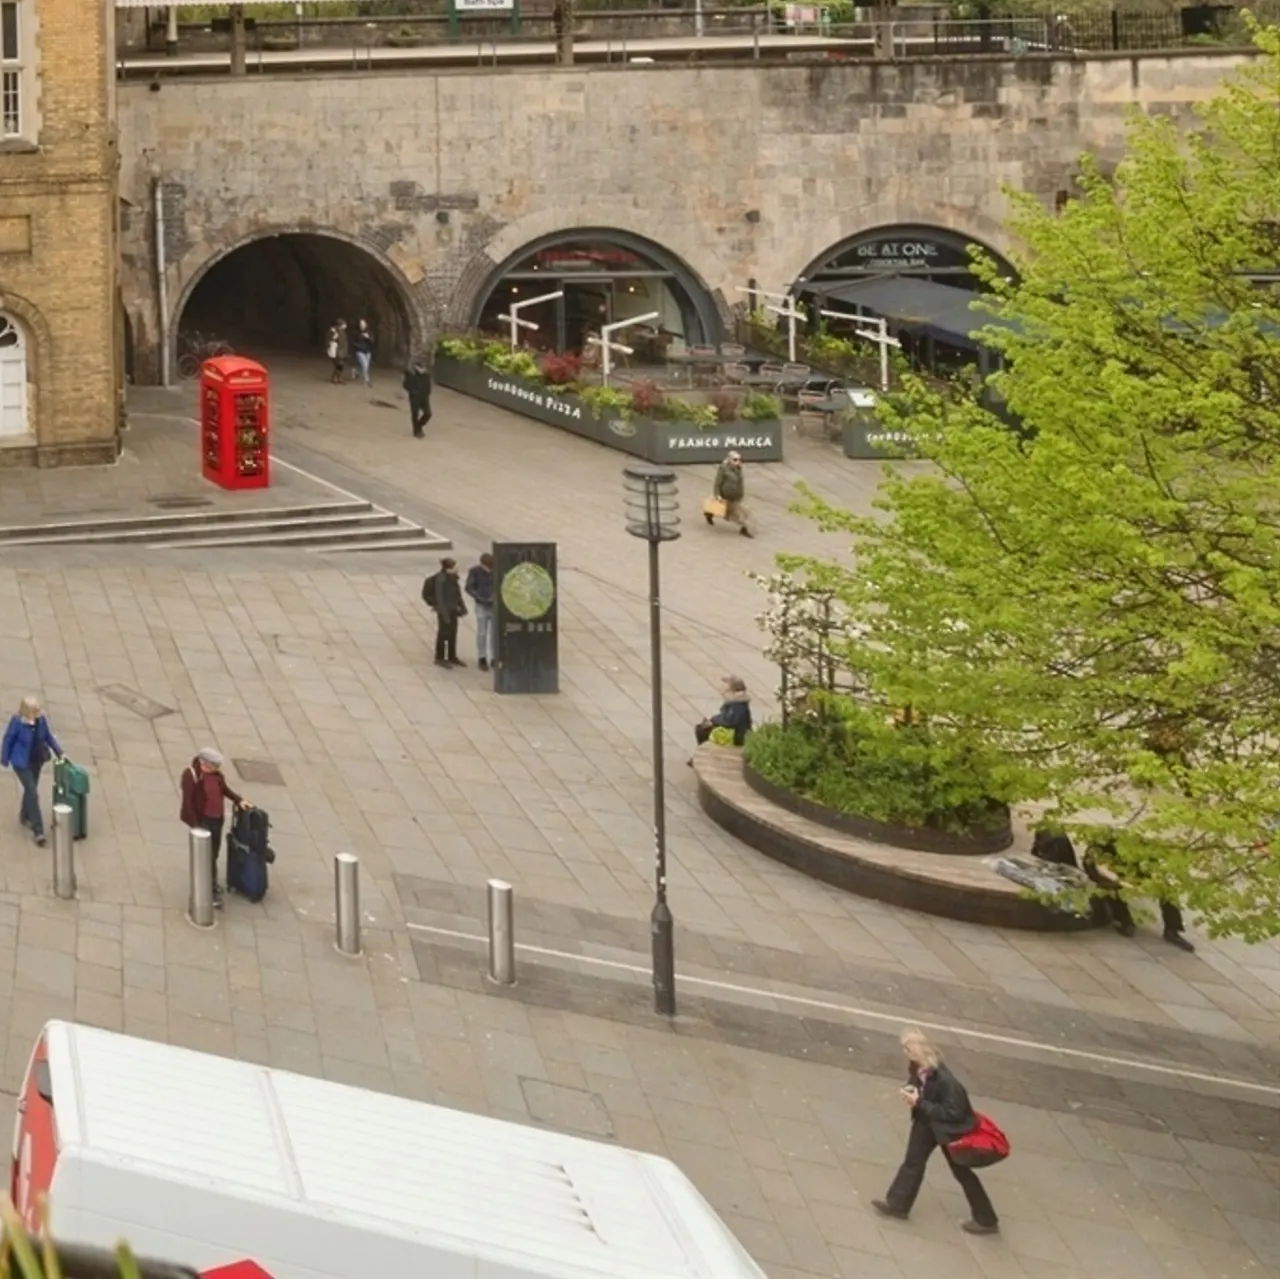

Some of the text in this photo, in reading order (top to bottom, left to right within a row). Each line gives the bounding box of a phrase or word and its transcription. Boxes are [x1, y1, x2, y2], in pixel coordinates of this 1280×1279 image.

[857, 242, 939, 257] BE AT ONE
[488, 378, 582, 420] SOURDOUGH PIZZA
[668, 435, 773, 449] FRANCO MANCA
